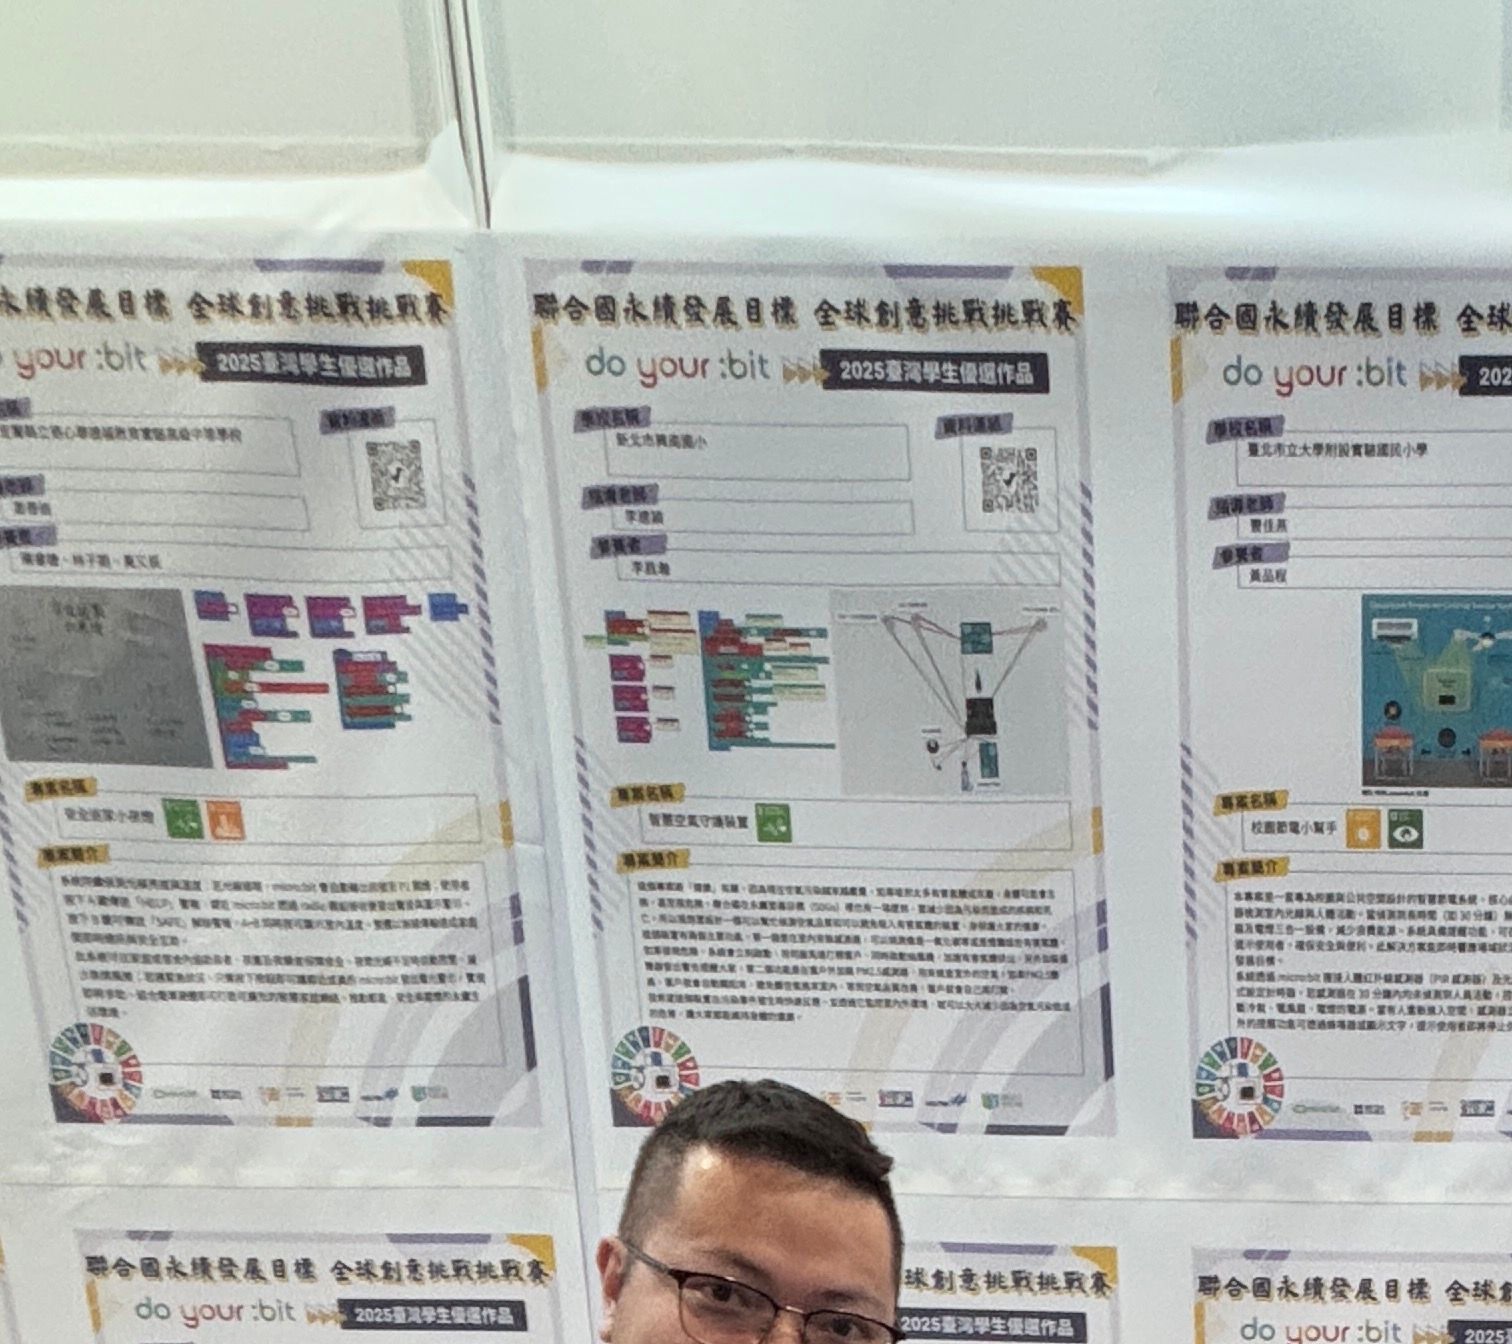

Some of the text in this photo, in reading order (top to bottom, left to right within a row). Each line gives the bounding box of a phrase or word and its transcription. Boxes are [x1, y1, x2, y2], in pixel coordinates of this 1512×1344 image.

[187, 288, 450, 326] 全球創意挑戰挑戰賽
[533, 292, 1078, 332] 聯合國永續發展目標 全球創意挑戰挑戰賽
[1173, 300, 1439, 336] 聯合國永續發展目標
[15, 343, 86, 379] your
[586, 347, 770, 389] do your :bit
[1223, 355, 1408, 398] do your :bit
[85, 1255, 551, 1288] 聯合國永續發展目標 全球創意挑戰挑戰賽
[1197, 1274, 1430, 1303] 聯合國永續發展目標
[135, 1296, 295, 1329] do your :bit
[1240, 1316, 1276, 1342] do
[1356, 1318, 1402, 1344] :bit
